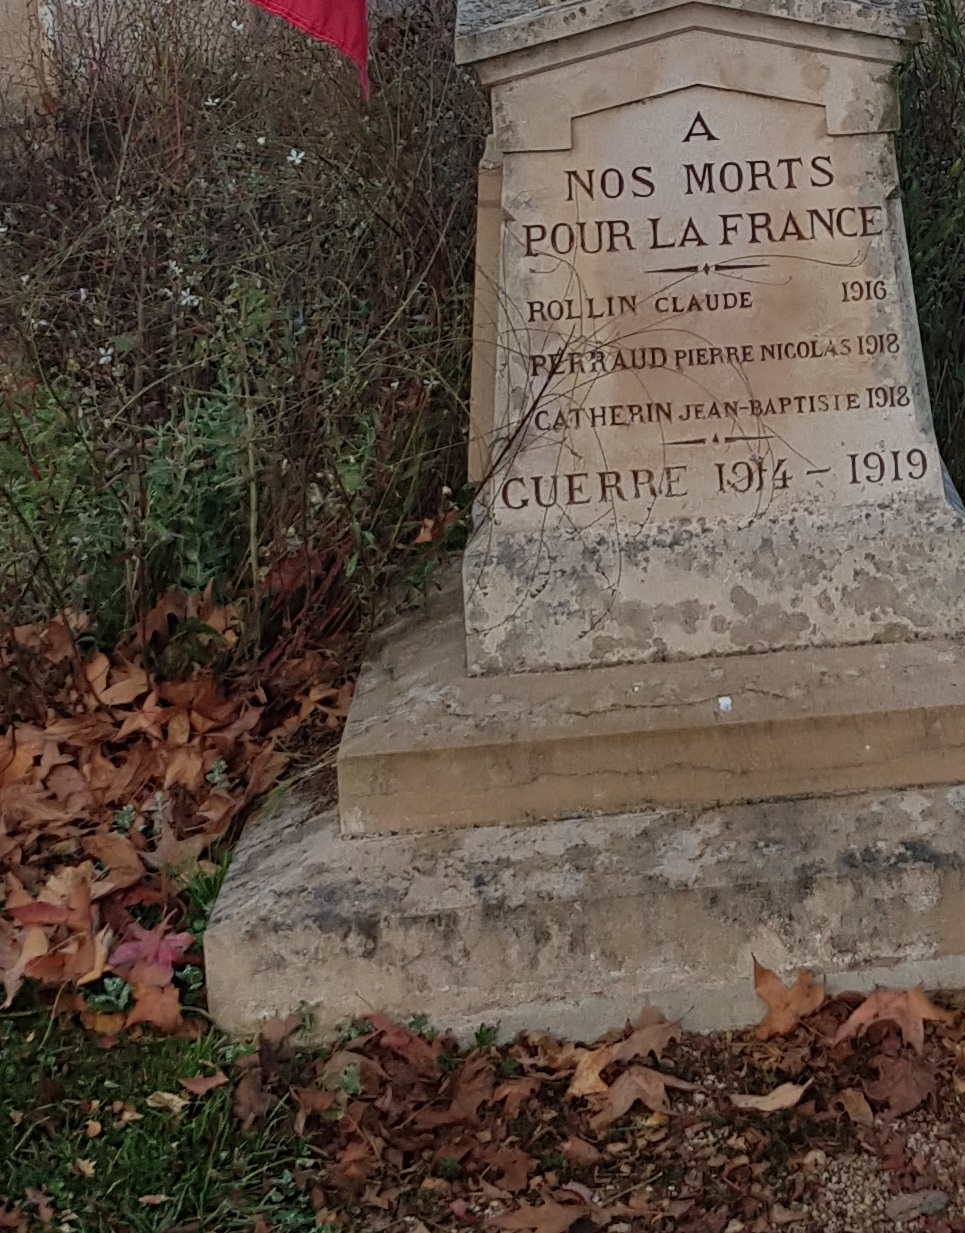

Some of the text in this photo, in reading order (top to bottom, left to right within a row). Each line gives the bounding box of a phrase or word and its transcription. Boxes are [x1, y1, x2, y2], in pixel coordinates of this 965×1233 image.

[682, 111, 720, 143] A
[565, 155, 835, 202] NOS MORTS
[523, 205, 883, 258] POUR LA FRANCE
[527, 280, 887, 323] ROLLIN CLAUDE 1916
[531, 333, 901, 377] PERRAUD PIERRE NICOLAS 1918
[534, 385, 911, 432] CATHERIN JEAN-BAPTISTE 1918
[501, 465, 688, 510] GUERRE
[716, 458, 793, 495] 1914
[848, 448, 928, 486] 1919
